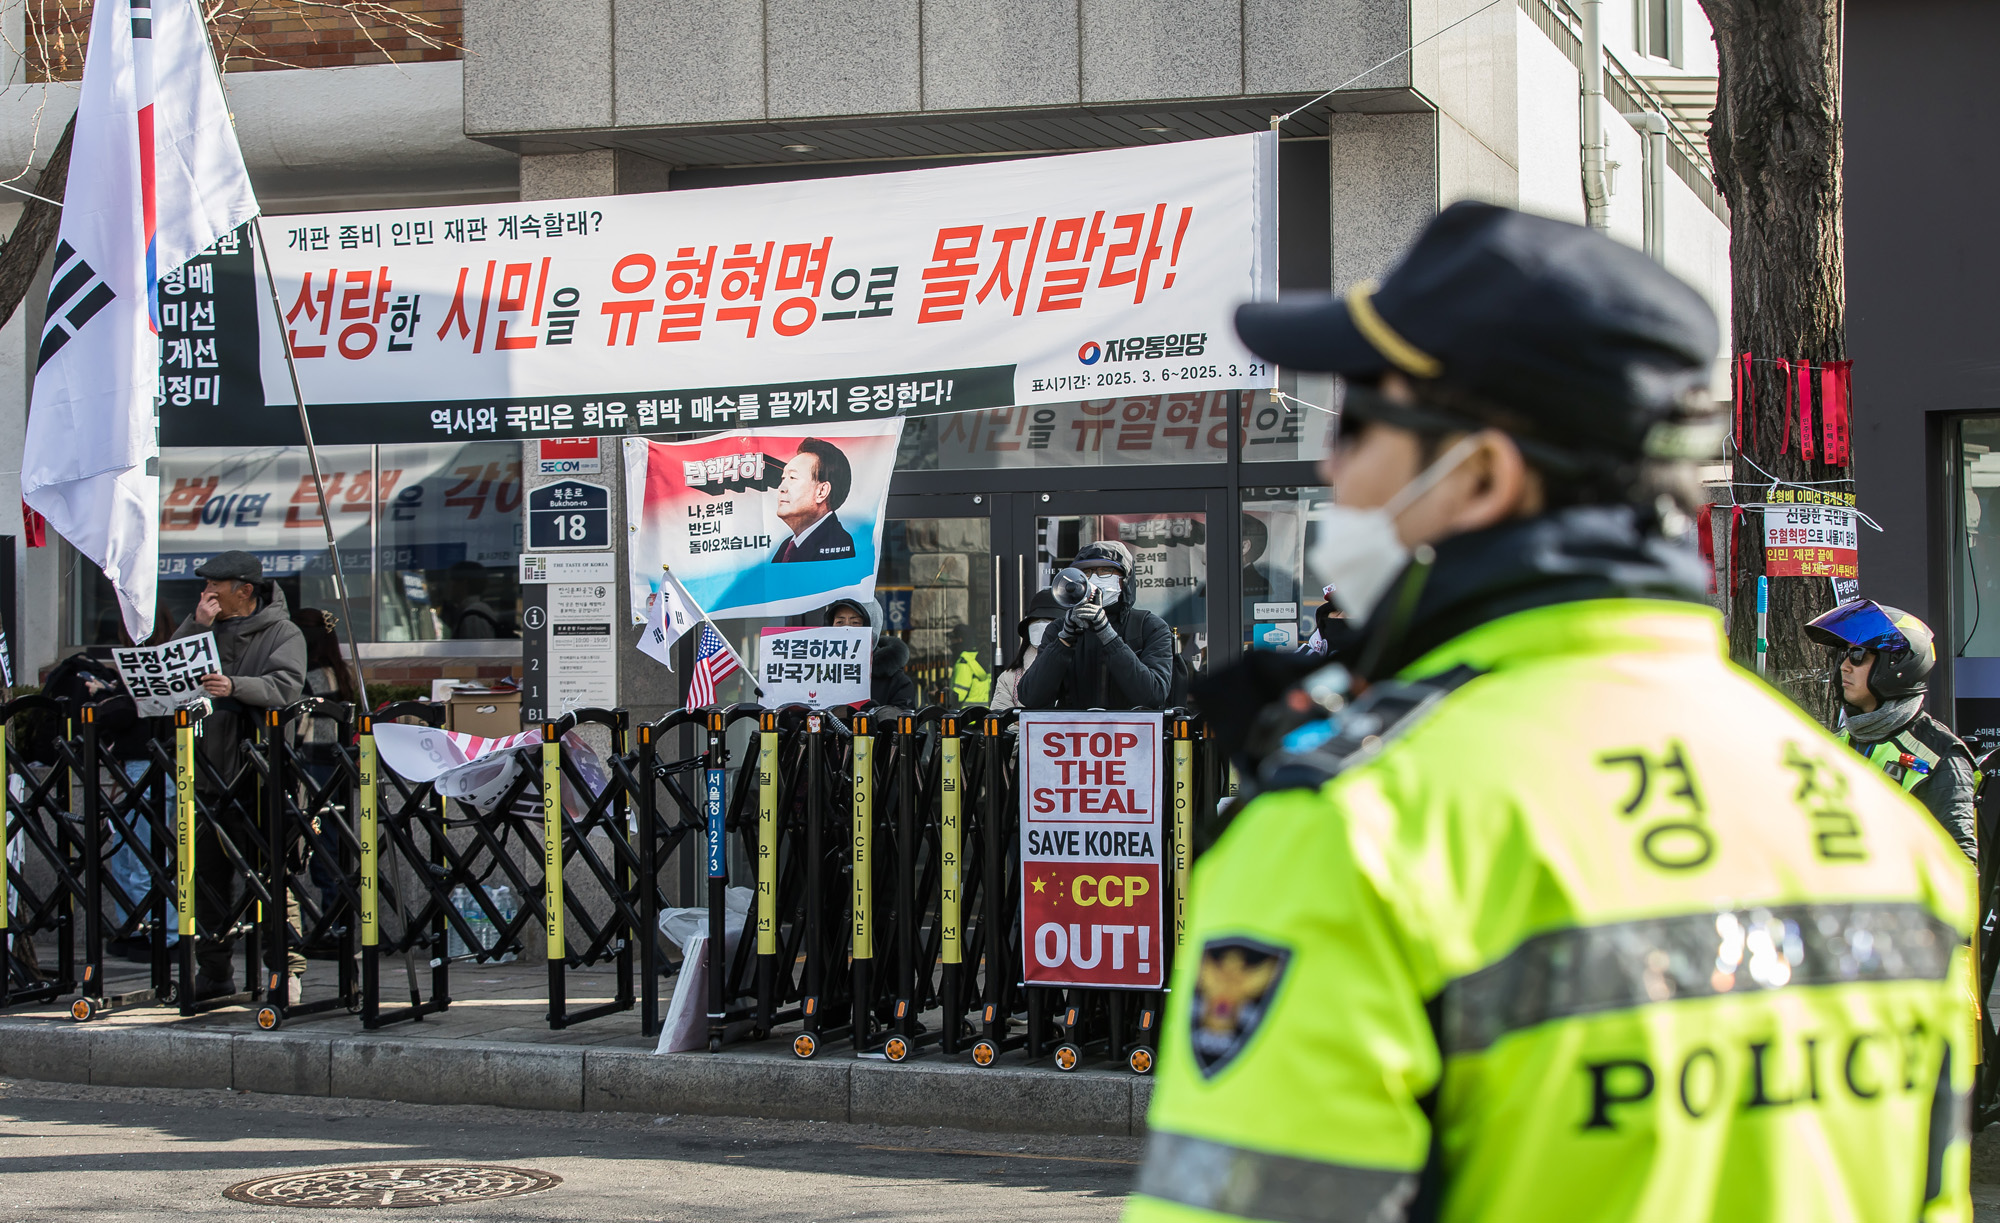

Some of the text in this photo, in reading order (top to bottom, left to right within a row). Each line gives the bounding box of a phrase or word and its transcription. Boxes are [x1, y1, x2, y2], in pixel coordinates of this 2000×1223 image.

[288, 210, 603, 251] 개판 좀비 인민 재판 계속할래?
[285, 203, 1193, 360] 선량한 시민을 유혈혁명으로 몰지말라!
[159, 338, 219, 369] 계선
[1103, 332, 1207, 362] 자유통일당
[1032, 363, 1267, 393] 표시기간: 2025. 3. 6~2025. 3. 21
[430, 379, 954, 434] 역사와 국민은 회유 협박 매수를 끝까지 응징한다!
[541, 461, 580, 473] SECOM
[684, 452, 765, 486] 탄핵각하
[159, 476, 272, 531] 법이면
[550, 500, 588, 508] Bukchon-ro
[554, 488, 584, 499] 북촌로
[1797, 489, 1821, 504] 이미선
[553, 514, 587, 541] 18
[689, 520, 721, 536] 반드시
[1118, 518, 1193, 541] 탄핵각하
[1769, 528, 1824, 545] 유혈혁명으로
[1825, 529, 1845, 546] 내몰지
[689, 535, 772, 555] 돌아오겠습니다
[819, 545, 851, 554] 국민희망시대
[1135, 552, 1168, 563] 윤석열
[1767, 548, 1834, 562] 인민 재판 끝에
[119, 637, 213, 674] 부정선거
[772, 639, 862, 660] 척결하자!
[531, 658, 539, 671] 2
[766, 663, 862, 684] 반국가세력
[532, 685, 539, 698] 1
[528, 708, 544, 720] B1
[1042, 731, 1138, 758] STOP
[1974, 727, 1995, 736] 스미레
[1054, 760, 1127, 785] THE
[178, 766, 186, 845] POLICE
[1033, 788, 1148, 814] STEAL
[360, 772, 372, 924] 질서유지선
[758, 772, 771, 932] 질서유지선
[855, 776, 865, 936] POLICE LINE
[1028, 830, 1155, 857] SAVE KOREA
[544, 782, 556, 936] POLICE LINE
[943, 778, 956, 940] 질서유지선
[1175, 782, 1186, 946] POLICE LINE
[1071, 874, 1150, 908] CCP
[1034, 922, 1151, 974] OUT!
